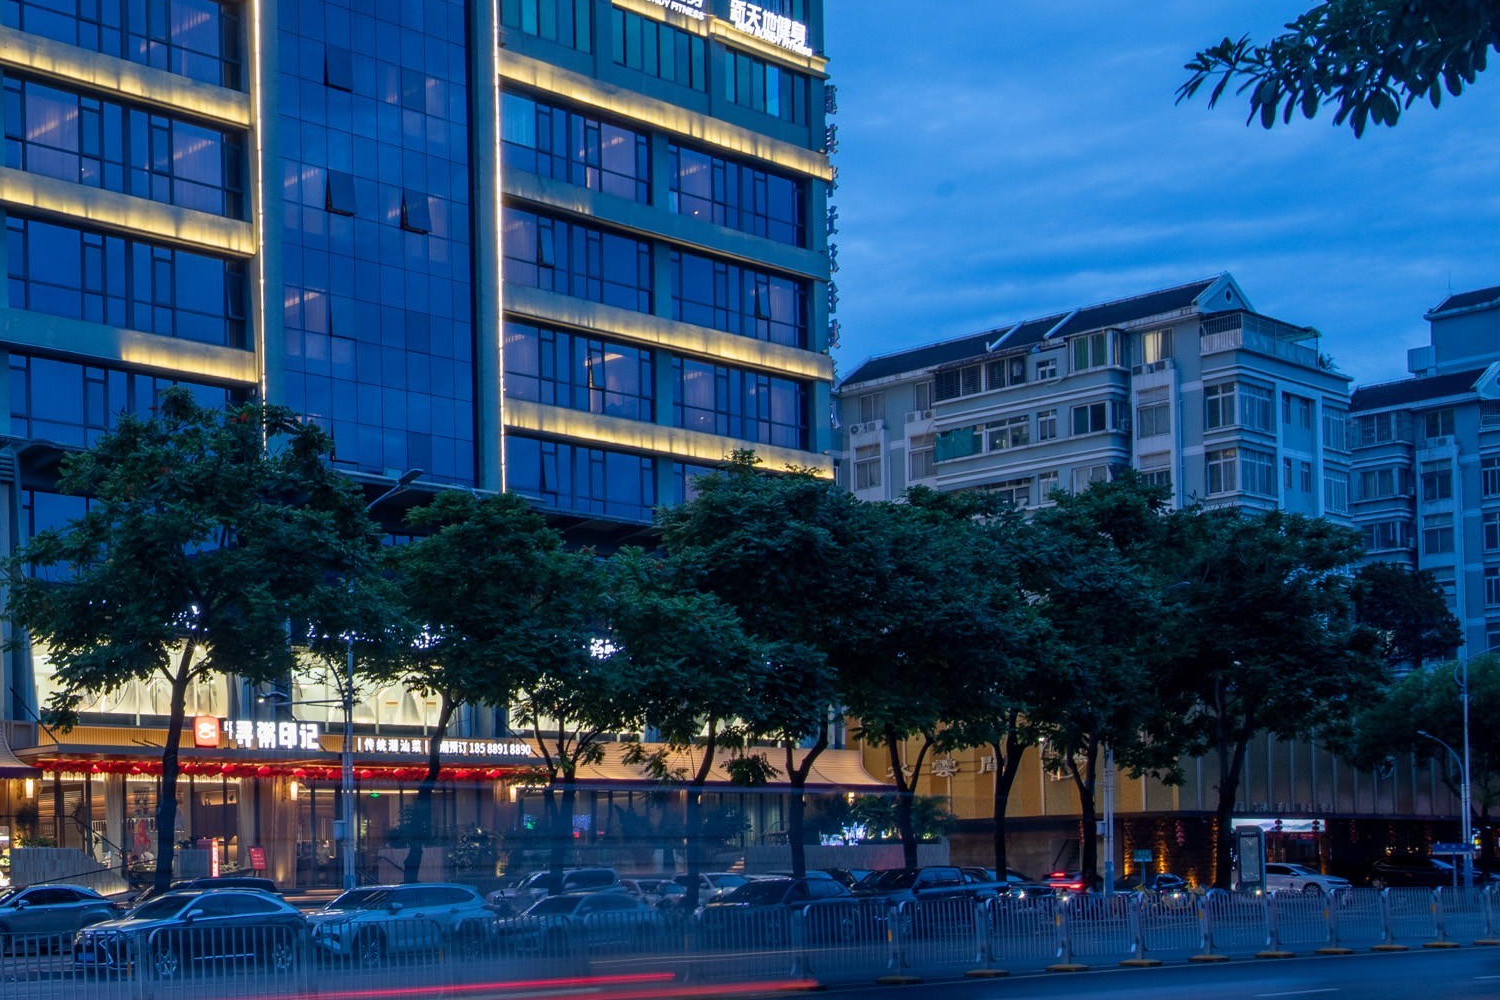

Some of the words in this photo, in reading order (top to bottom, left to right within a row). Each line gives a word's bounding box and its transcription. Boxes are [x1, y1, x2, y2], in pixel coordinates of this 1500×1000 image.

[671, 0, 705, 21] FITNESS
[469, 742, 486, 754] 185
[487, 743, 508, 755] 8891
[509, 744, 531, 756] 8890
